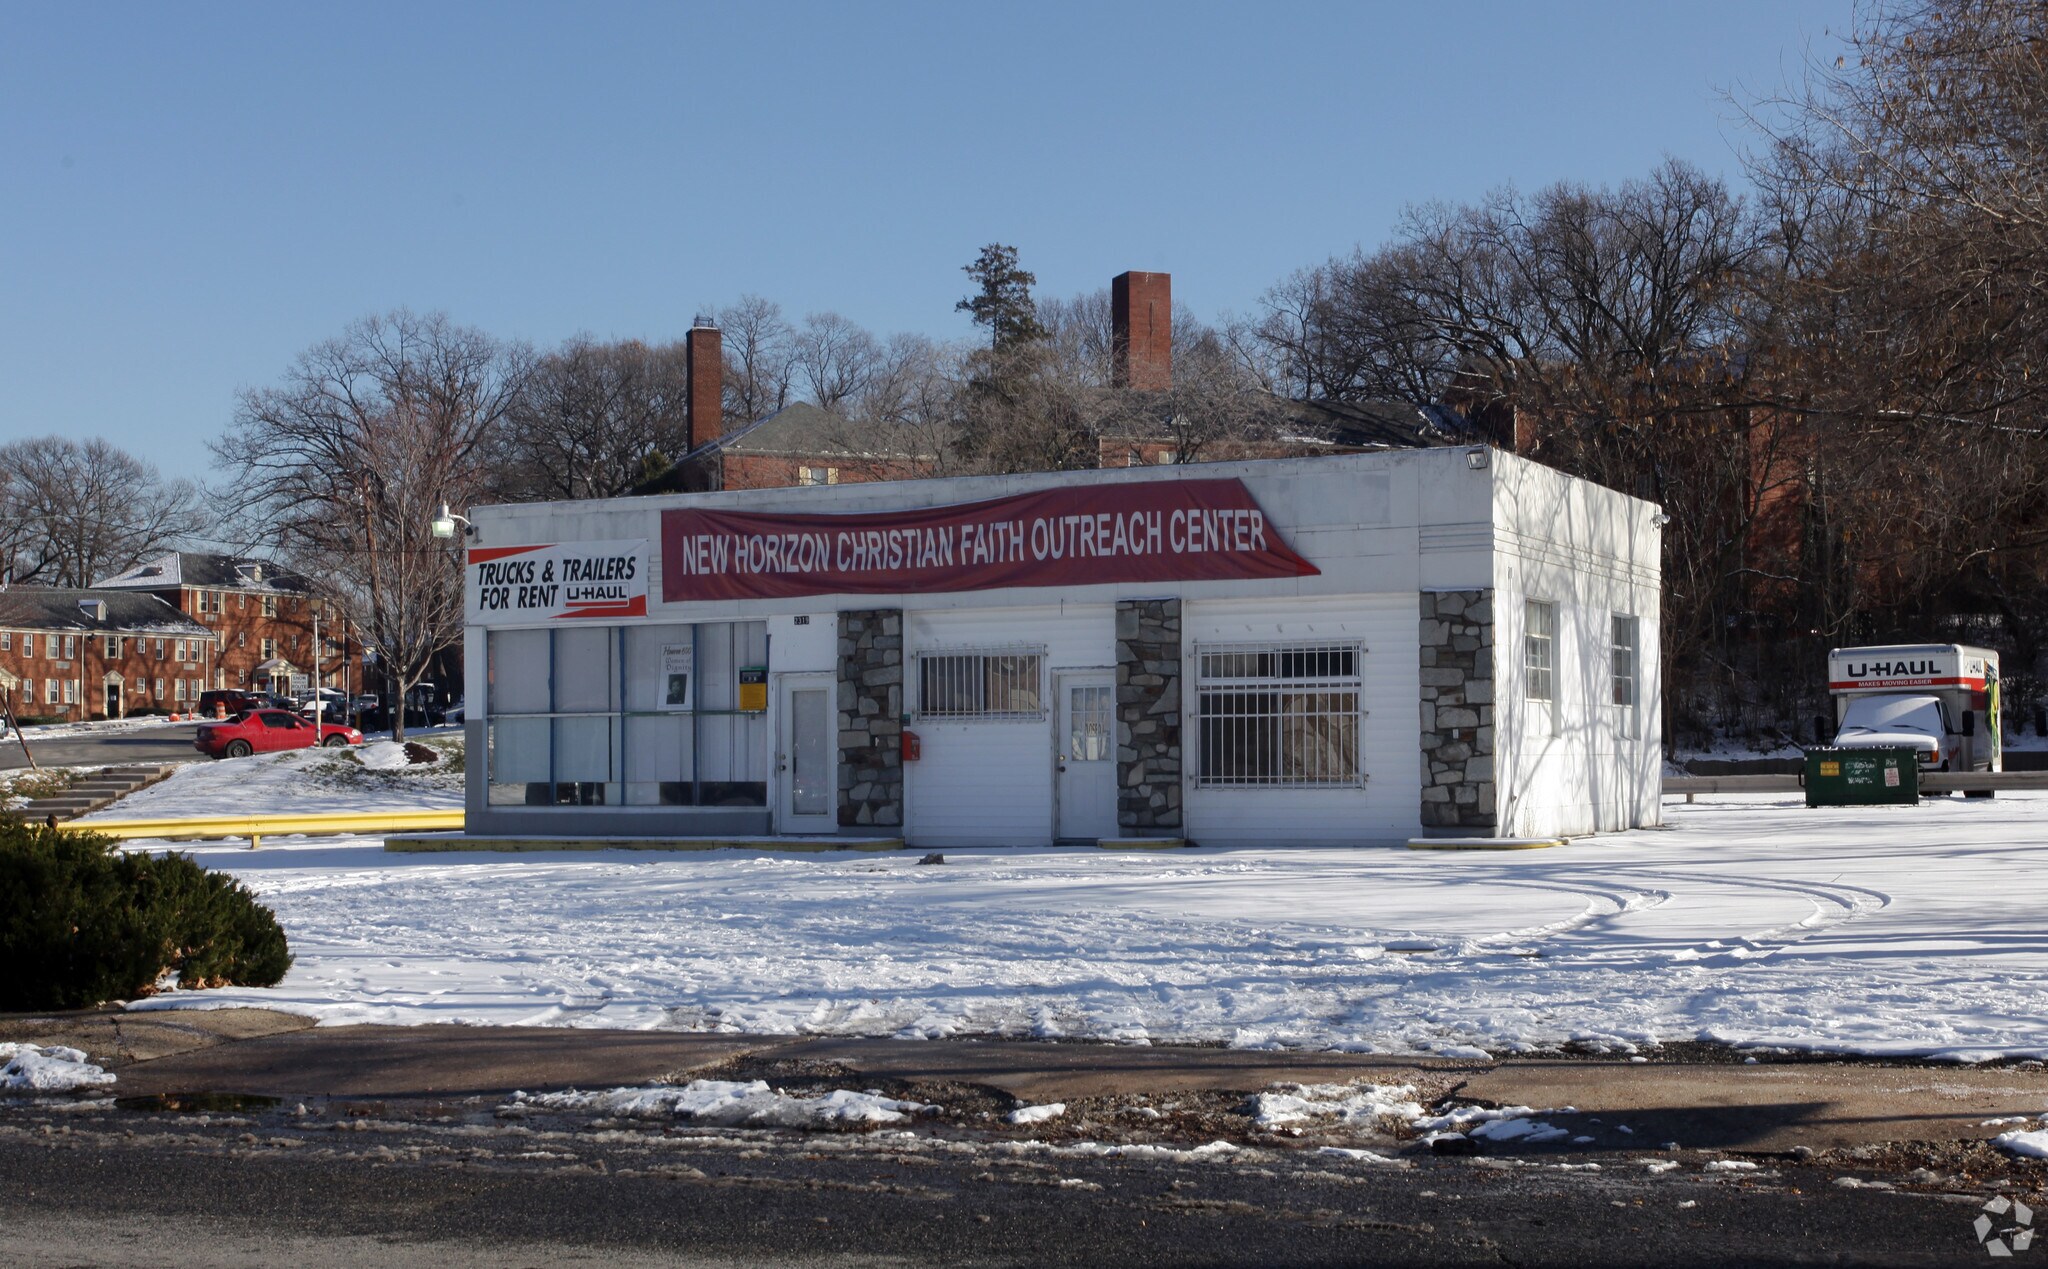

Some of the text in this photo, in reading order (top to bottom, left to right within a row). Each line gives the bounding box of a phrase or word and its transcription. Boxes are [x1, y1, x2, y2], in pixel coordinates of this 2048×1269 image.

[683, 509, 1267, 575] NEW HORIZON CHRISTIAN FAITH OUTREACH CENTER
[478, 556, 637, 586] TRUCKS & TRAILERS
[479, 584, 559, 610] FOR RENT
